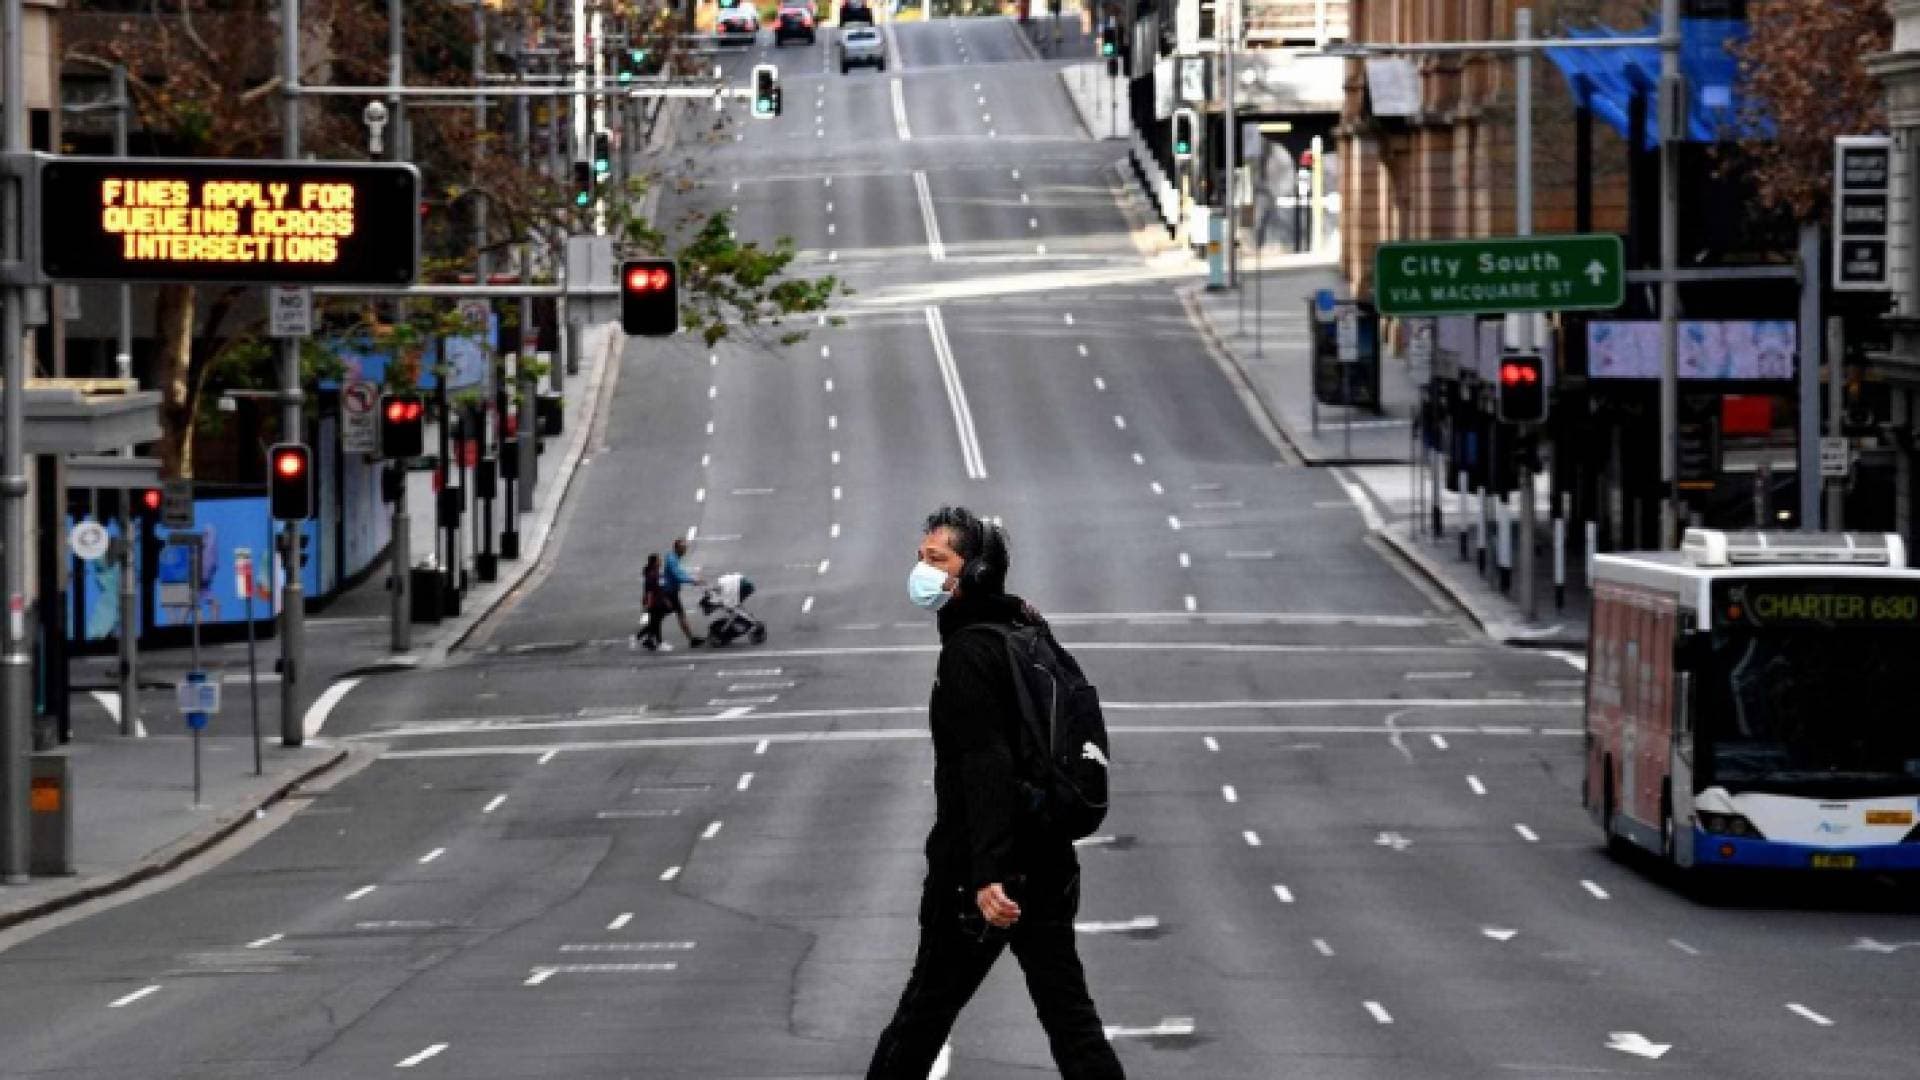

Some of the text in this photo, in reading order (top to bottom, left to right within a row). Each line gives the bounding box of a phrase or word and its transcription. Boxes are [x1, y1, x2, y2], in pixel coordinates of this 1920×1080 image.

[102, 179, 354, 209] FINES APPLY FOR
[103, 207, 354, 236] QUEUEING ACROSS
[123, 234, 338, 262] INTERSECTIONS
[1401, 253, 1561, 278] City South
[1389, 280, 1573, 301] VIA MACQUARIE ST
[1755, 593, 1865, 619] CHARTER
